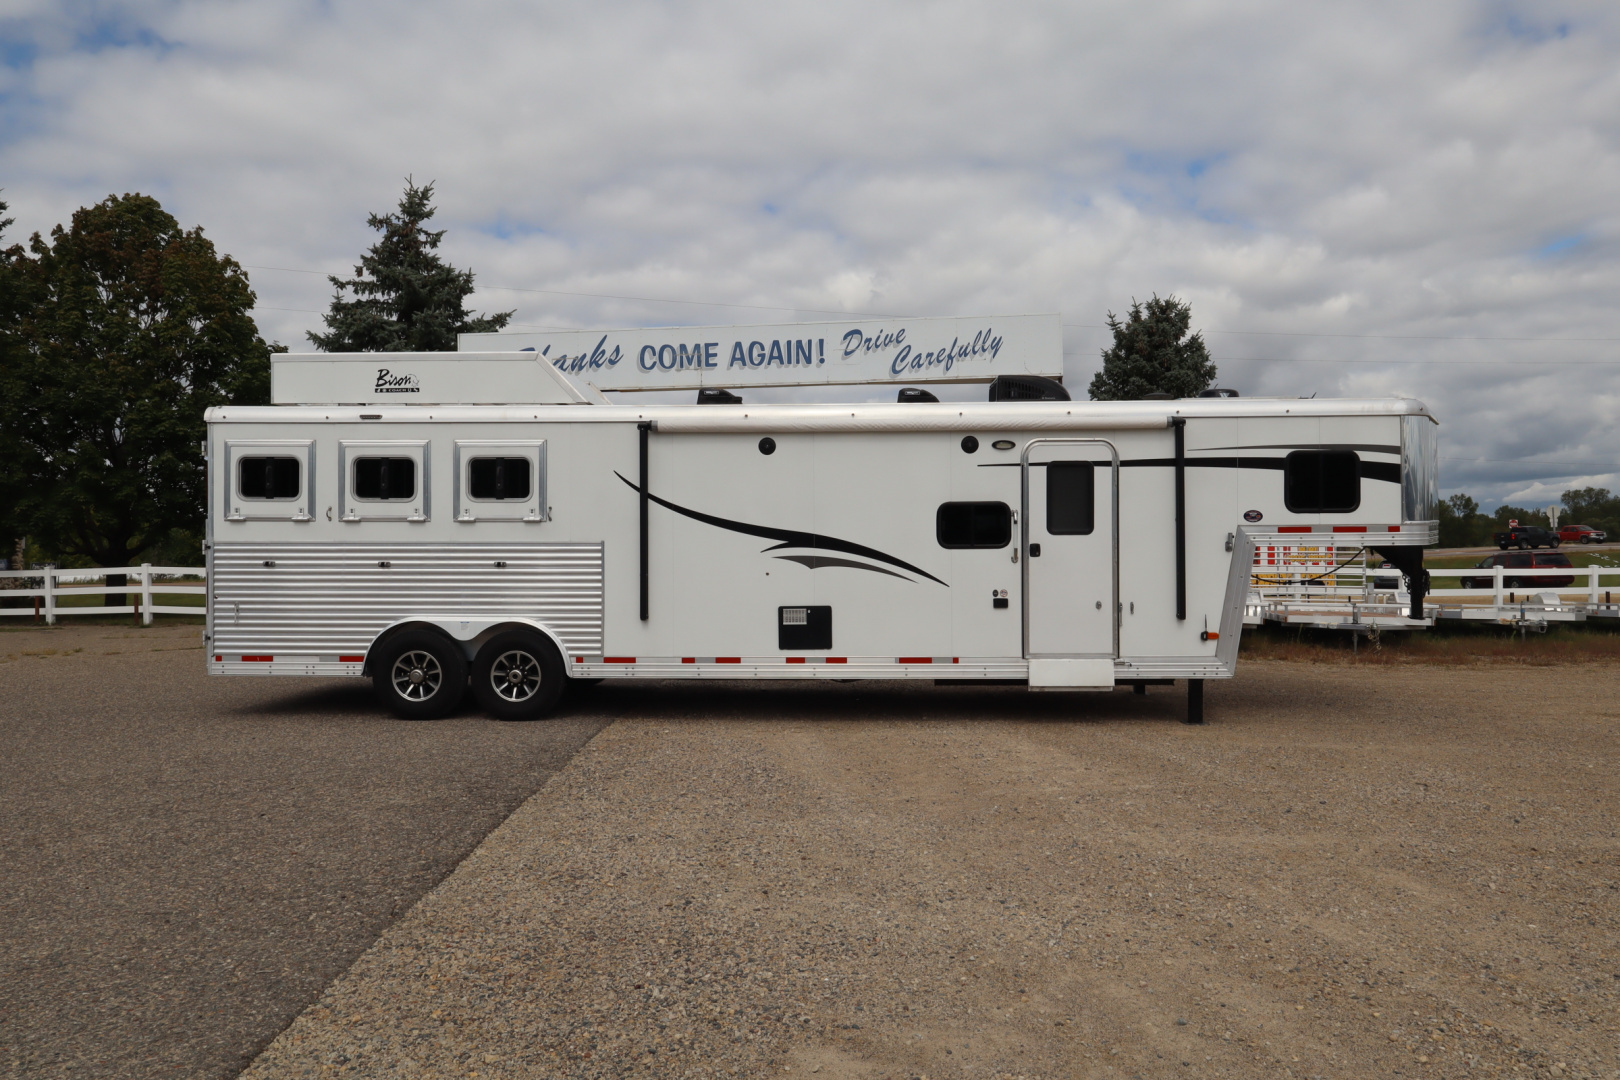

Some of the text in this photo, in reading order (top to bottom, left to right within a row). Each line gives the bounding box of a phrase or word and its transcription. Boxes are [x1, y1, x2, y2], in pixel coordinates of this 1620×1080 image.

[519, 334, 826, 373] anks COME AGAIN!
[842, 328, 907, 357] Drive
[890, 327, 1004, 375] Carefully
[375, 368, 412, 388] Bison
